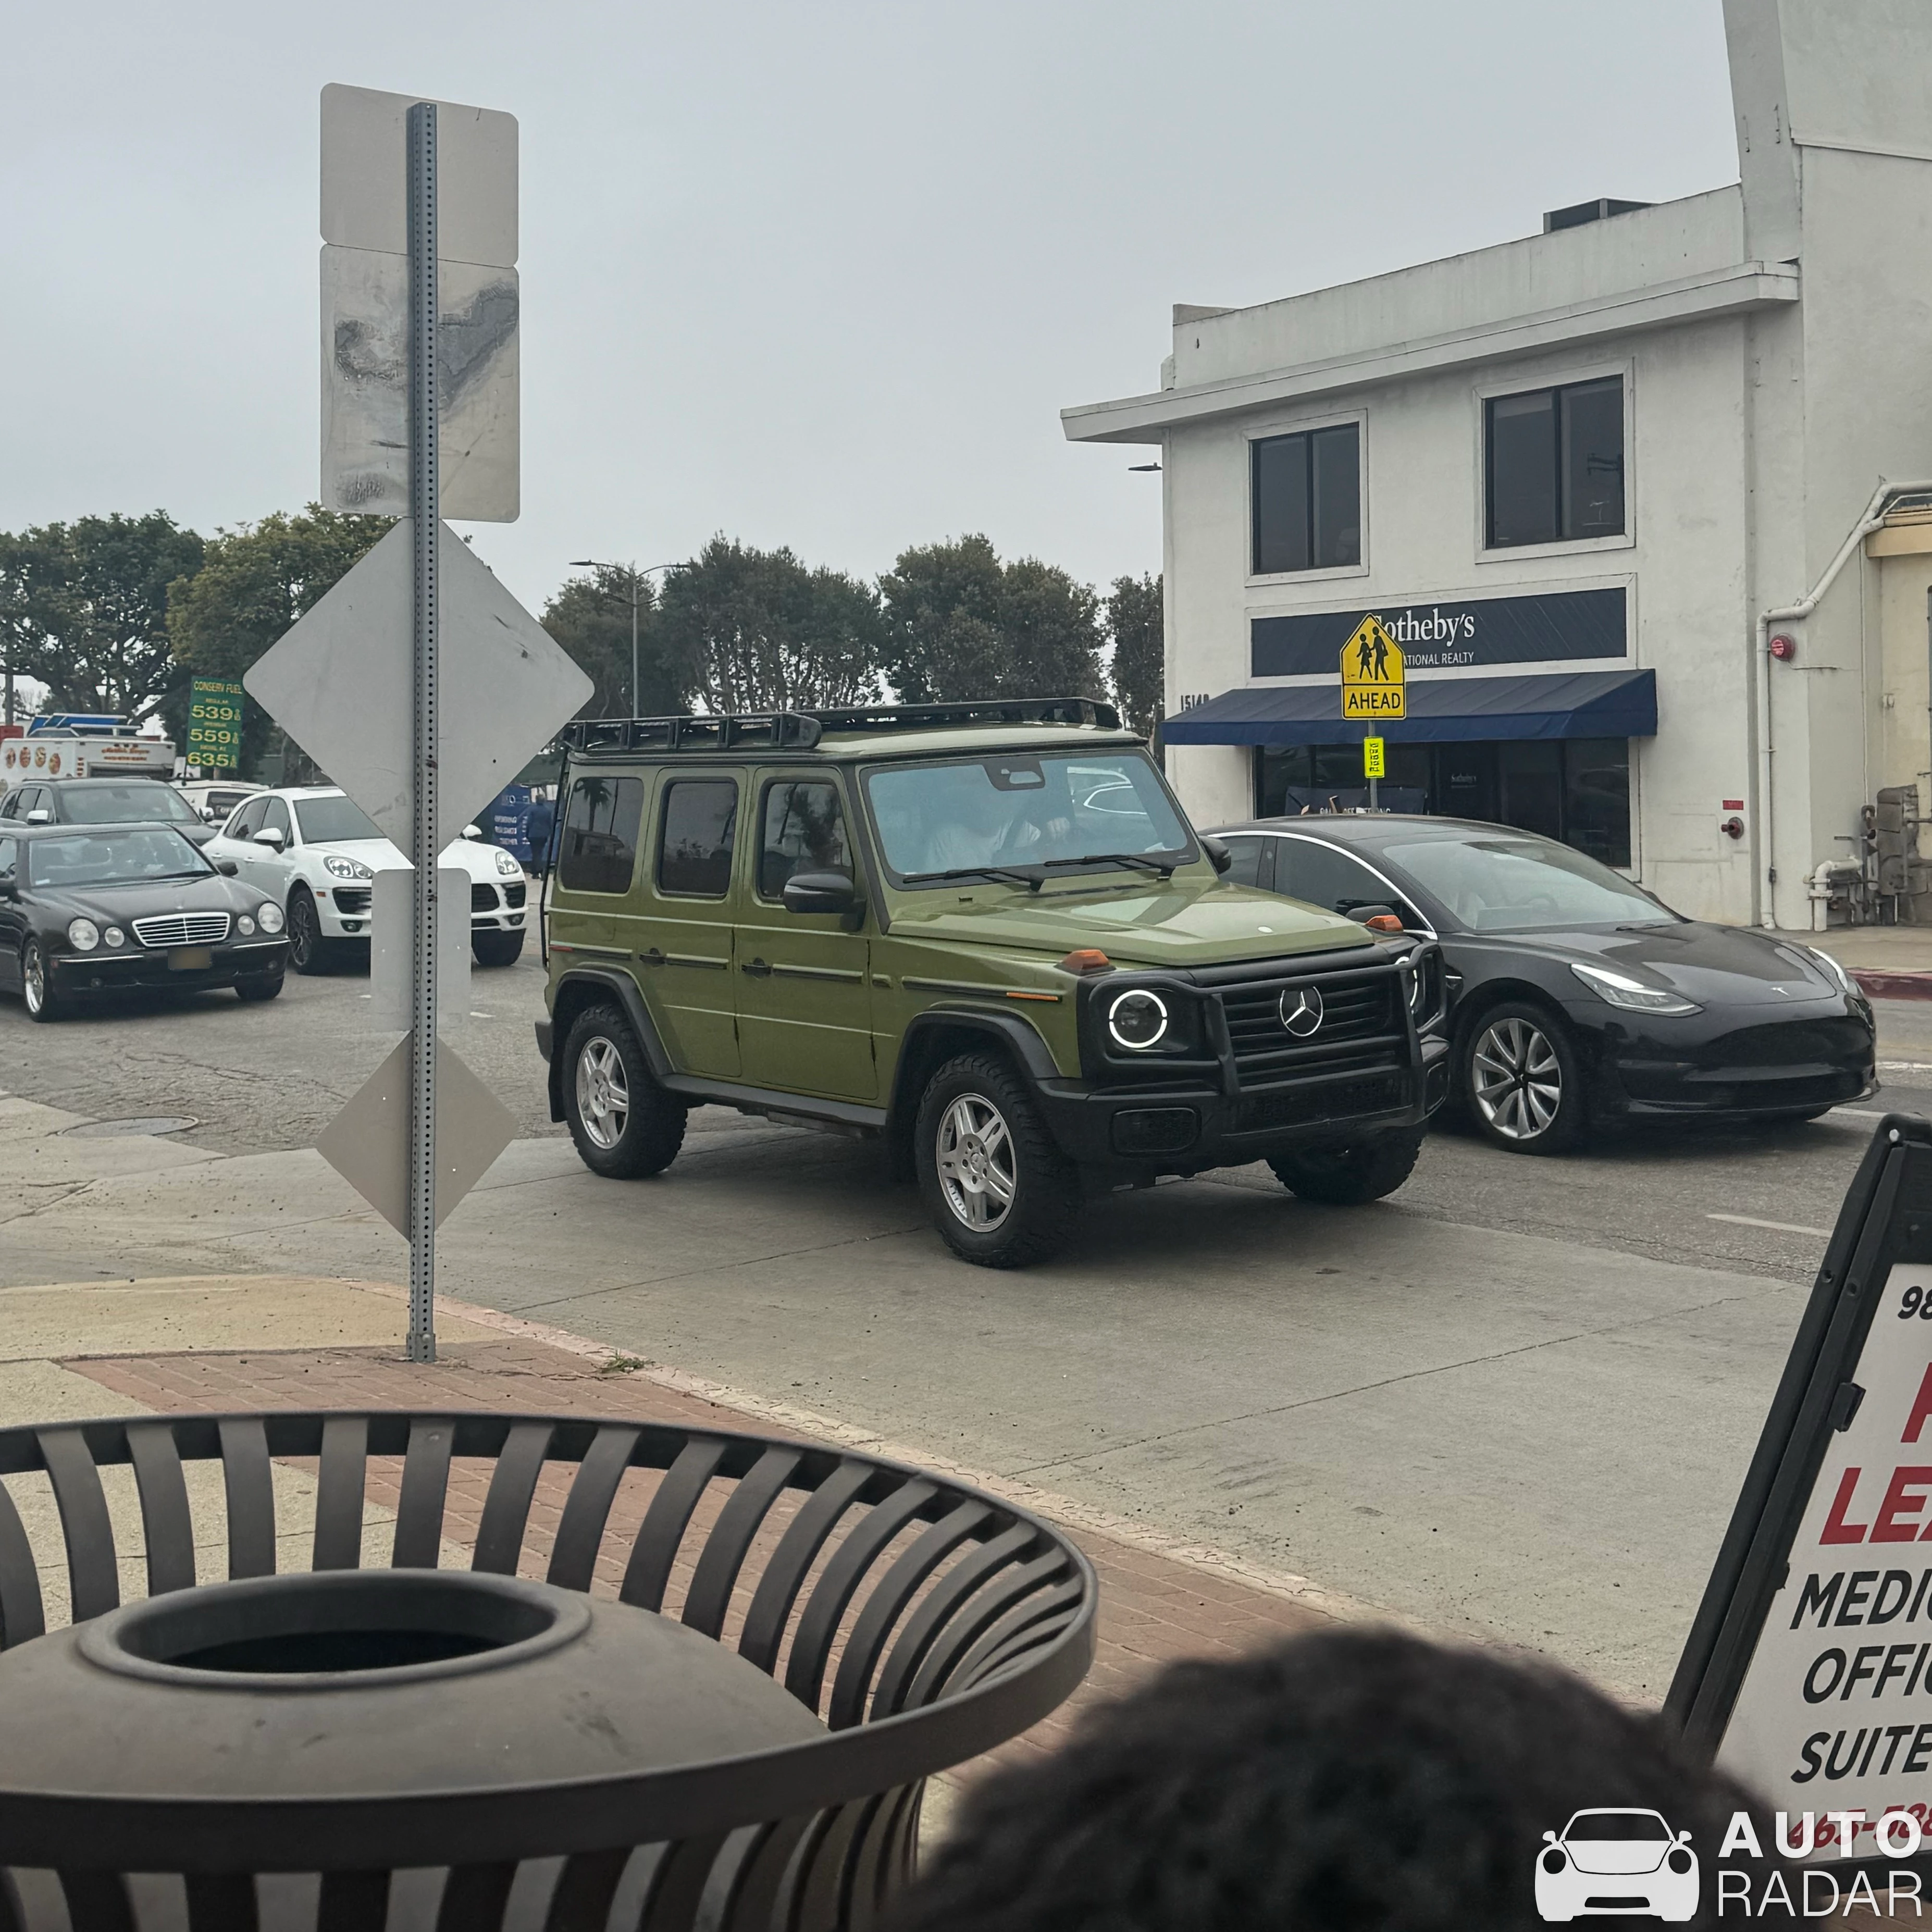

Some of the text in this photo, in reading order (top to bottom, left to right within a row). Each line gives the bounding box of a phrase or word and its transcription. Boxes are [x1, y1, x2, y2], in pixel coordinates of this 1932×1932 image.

[1442, 652, 1474, 664] REALTY
[1348, 692, 1401, 709] AHEAD
[191, 705, 233, 721] 539
[189, 728, 231, 744] 559
[187, 752, 229, 767] 635
[1818, 1466, 1932, 1545] LE
[1789, 1568, 1932, 1630] MEDI
[1802, 1643, 1932, 1704] OFFI
[1790, 1724, 1932, 1784] SUITE
